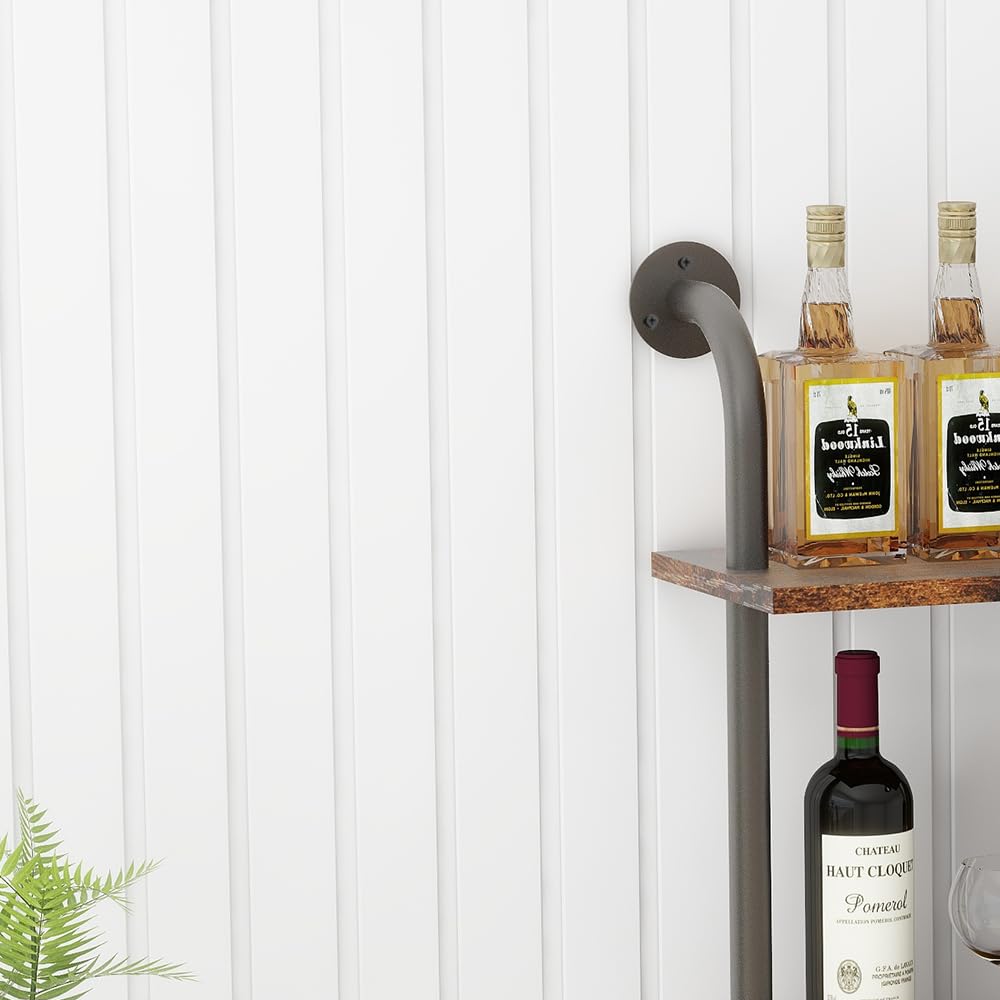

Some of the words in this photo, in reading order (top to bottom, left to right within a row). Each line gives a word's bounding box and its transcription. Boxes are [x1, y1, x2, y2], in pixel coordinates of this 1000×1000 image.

[855, 844, 901, 856] CHATEAU
[826, 864, 865, 878] HAUT
[844, 889, 908, 914] Pomerol
